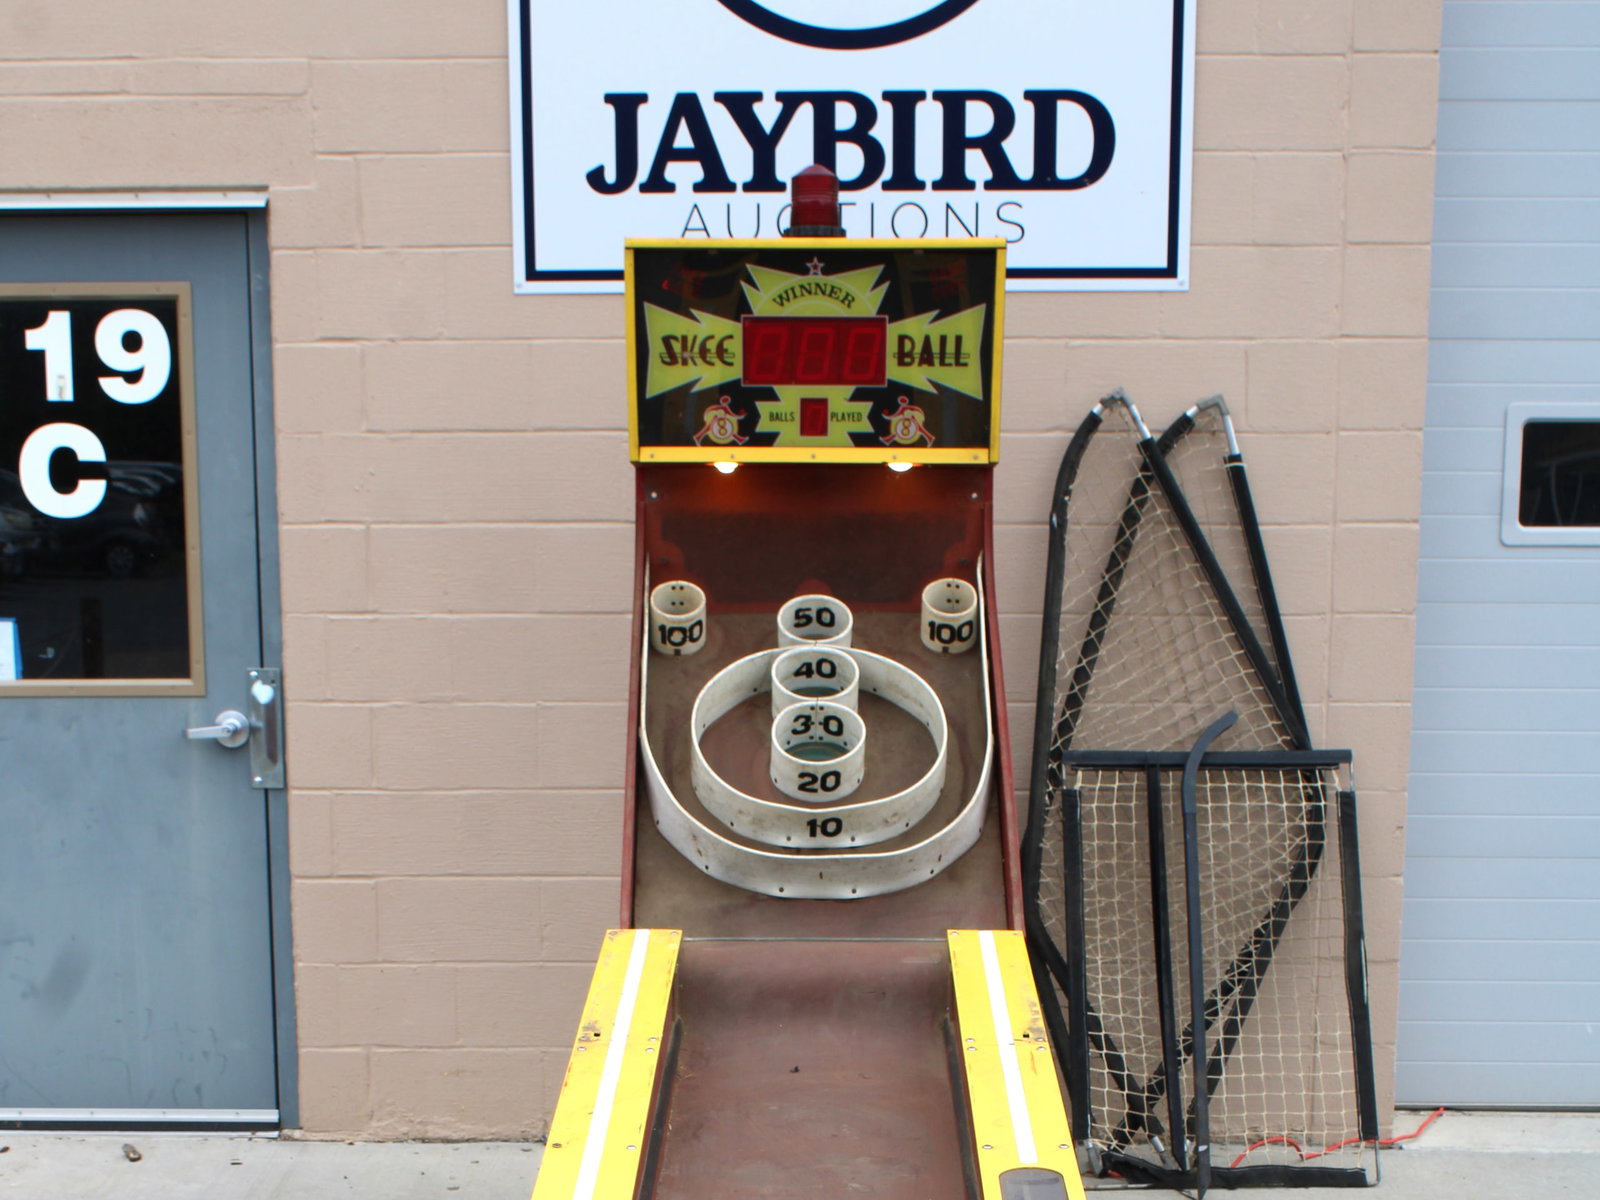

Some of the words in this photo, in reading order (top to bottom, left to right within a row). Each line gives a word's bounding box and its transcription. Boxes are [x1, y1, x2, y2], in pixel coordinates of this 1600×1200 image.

[585, 88, 1117, 195] JAYBIRD
[772, 282, 856, 309] WINNER
[24, 308, 172, 405] 19
[660, 334, 736, 367] SKEE
[895, 334, 970, 368] BALL
[768, 411, 796, 423] BALLS
[829, 411, 864, 423] PLAYED
[18, 421, 108, 520] C
[792, 606, 837, 629] 50
[658, 619, 704, 647] 100
[927, 618, 975, 644] 100
[792, 657, 838, 680] 40
[796, 769, 842, 794] 20
[805, 816, 844, 839] 10
